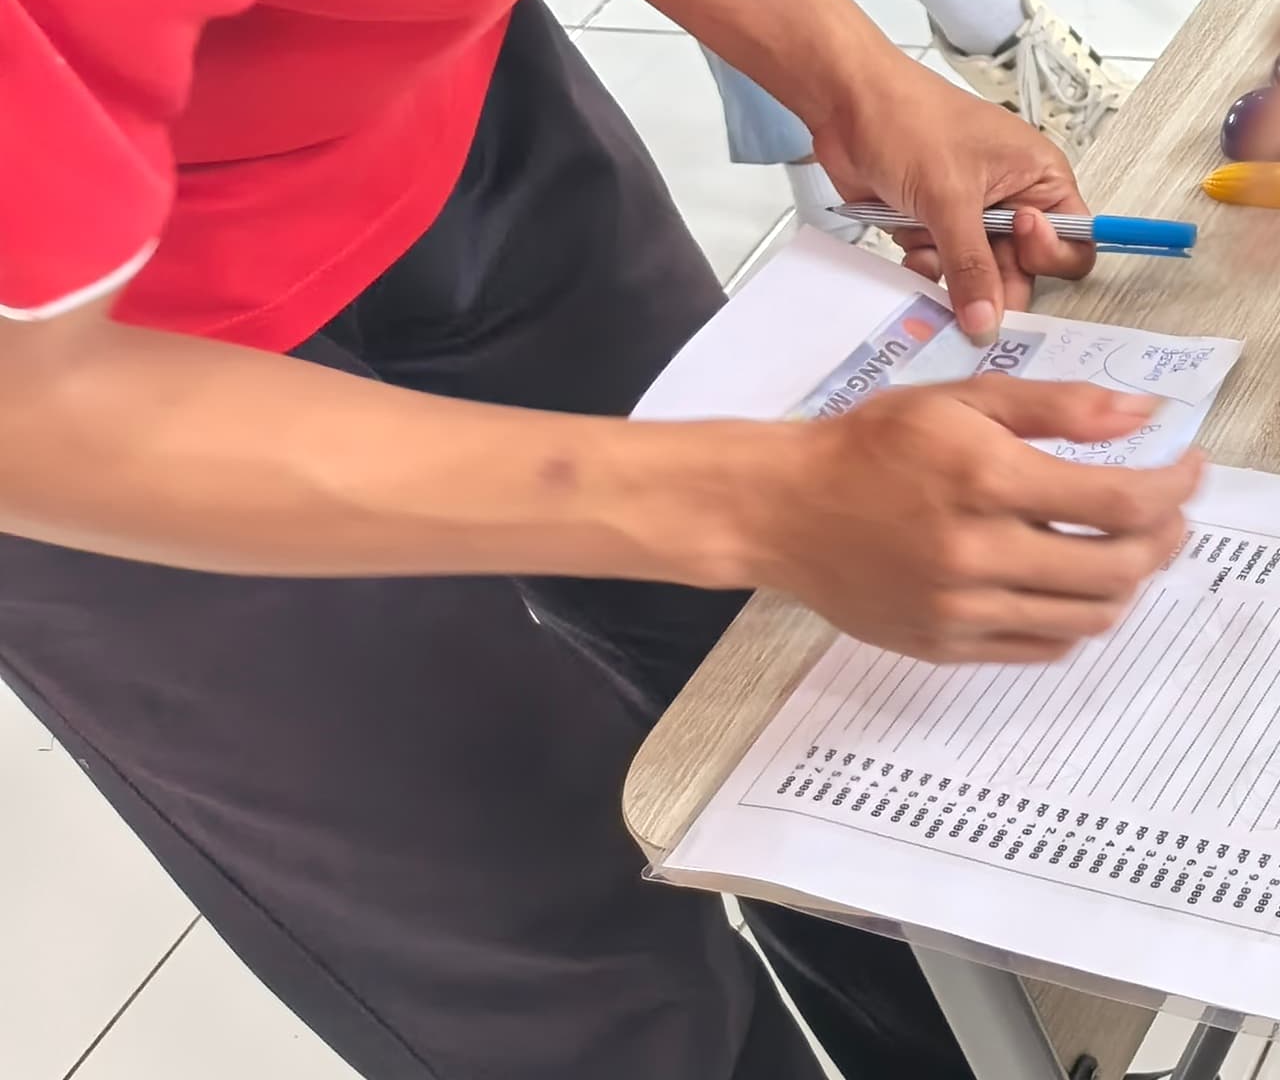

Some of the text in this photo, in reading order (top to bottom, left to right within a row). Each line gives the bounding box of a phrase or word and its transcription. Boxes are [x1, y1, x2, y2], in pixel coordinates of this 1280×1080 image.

[844, 339, 909, 395] UANG
[1002, 535, 1232, 861] BAKSO RP 10.000
[1027, 539, 1250, 860] SAUS TOMAT RP 2.000
[1047, 543, 1268, 865] INDOMIE RP 6.000
[805, 744, 820, 759] RP
[793, 747, 838, 798] RP 7.000
[811, 751, 857, 802] RP 5.000
[830, 756, 876, 807] RP 5.000
[849, 761, 895, 812] RP 4.000
[869, 767, 914, 818] RP 4.000
[888, 771, 933, 823] RP 5.000
[908, 776, 953, 828] RP 8.000
[923, 781, 972, 839] RP 10.000
[995, 791, 1011, 808] RP
[1015, 796, 1031, 813] RP
[947, 786, 992, 838] RP 6.000
[967, 810, 998, 844] 9.000
[1094, 815, 1110, 831] RP
[1113, 819, 1130, 836] RP
[987, 815, 1017, 849] 9.000
[1134, 824, 1150, 841] RP
[1153, 829, 1170, 846] RP
[1174, 833, 1190, 850] RP
[1194, 837, 1210, 855] RP
[1214, 842, 1231, 859] RP
[1067, 834, 1097, 870] 5.000
[1087, 838, 1116, 874] 4.000
[1107, 843, 1136, 880] 4.000
[1128, 848, 1157, 884] 3.000
[1235, 847, 1251, 864] RP
[1256, 851, 1272, 869] RP
[1148, 853, 1178, 889] 3.000
[1168, 857, 1197, 894] 6.000
[1185, 864, 1218, 905] 10.000
[1210, 867, 1239, 904] 9.000
[1231, 872, 1260, 909] 9.000
[1252, 876, 1280, 914] 8.000
